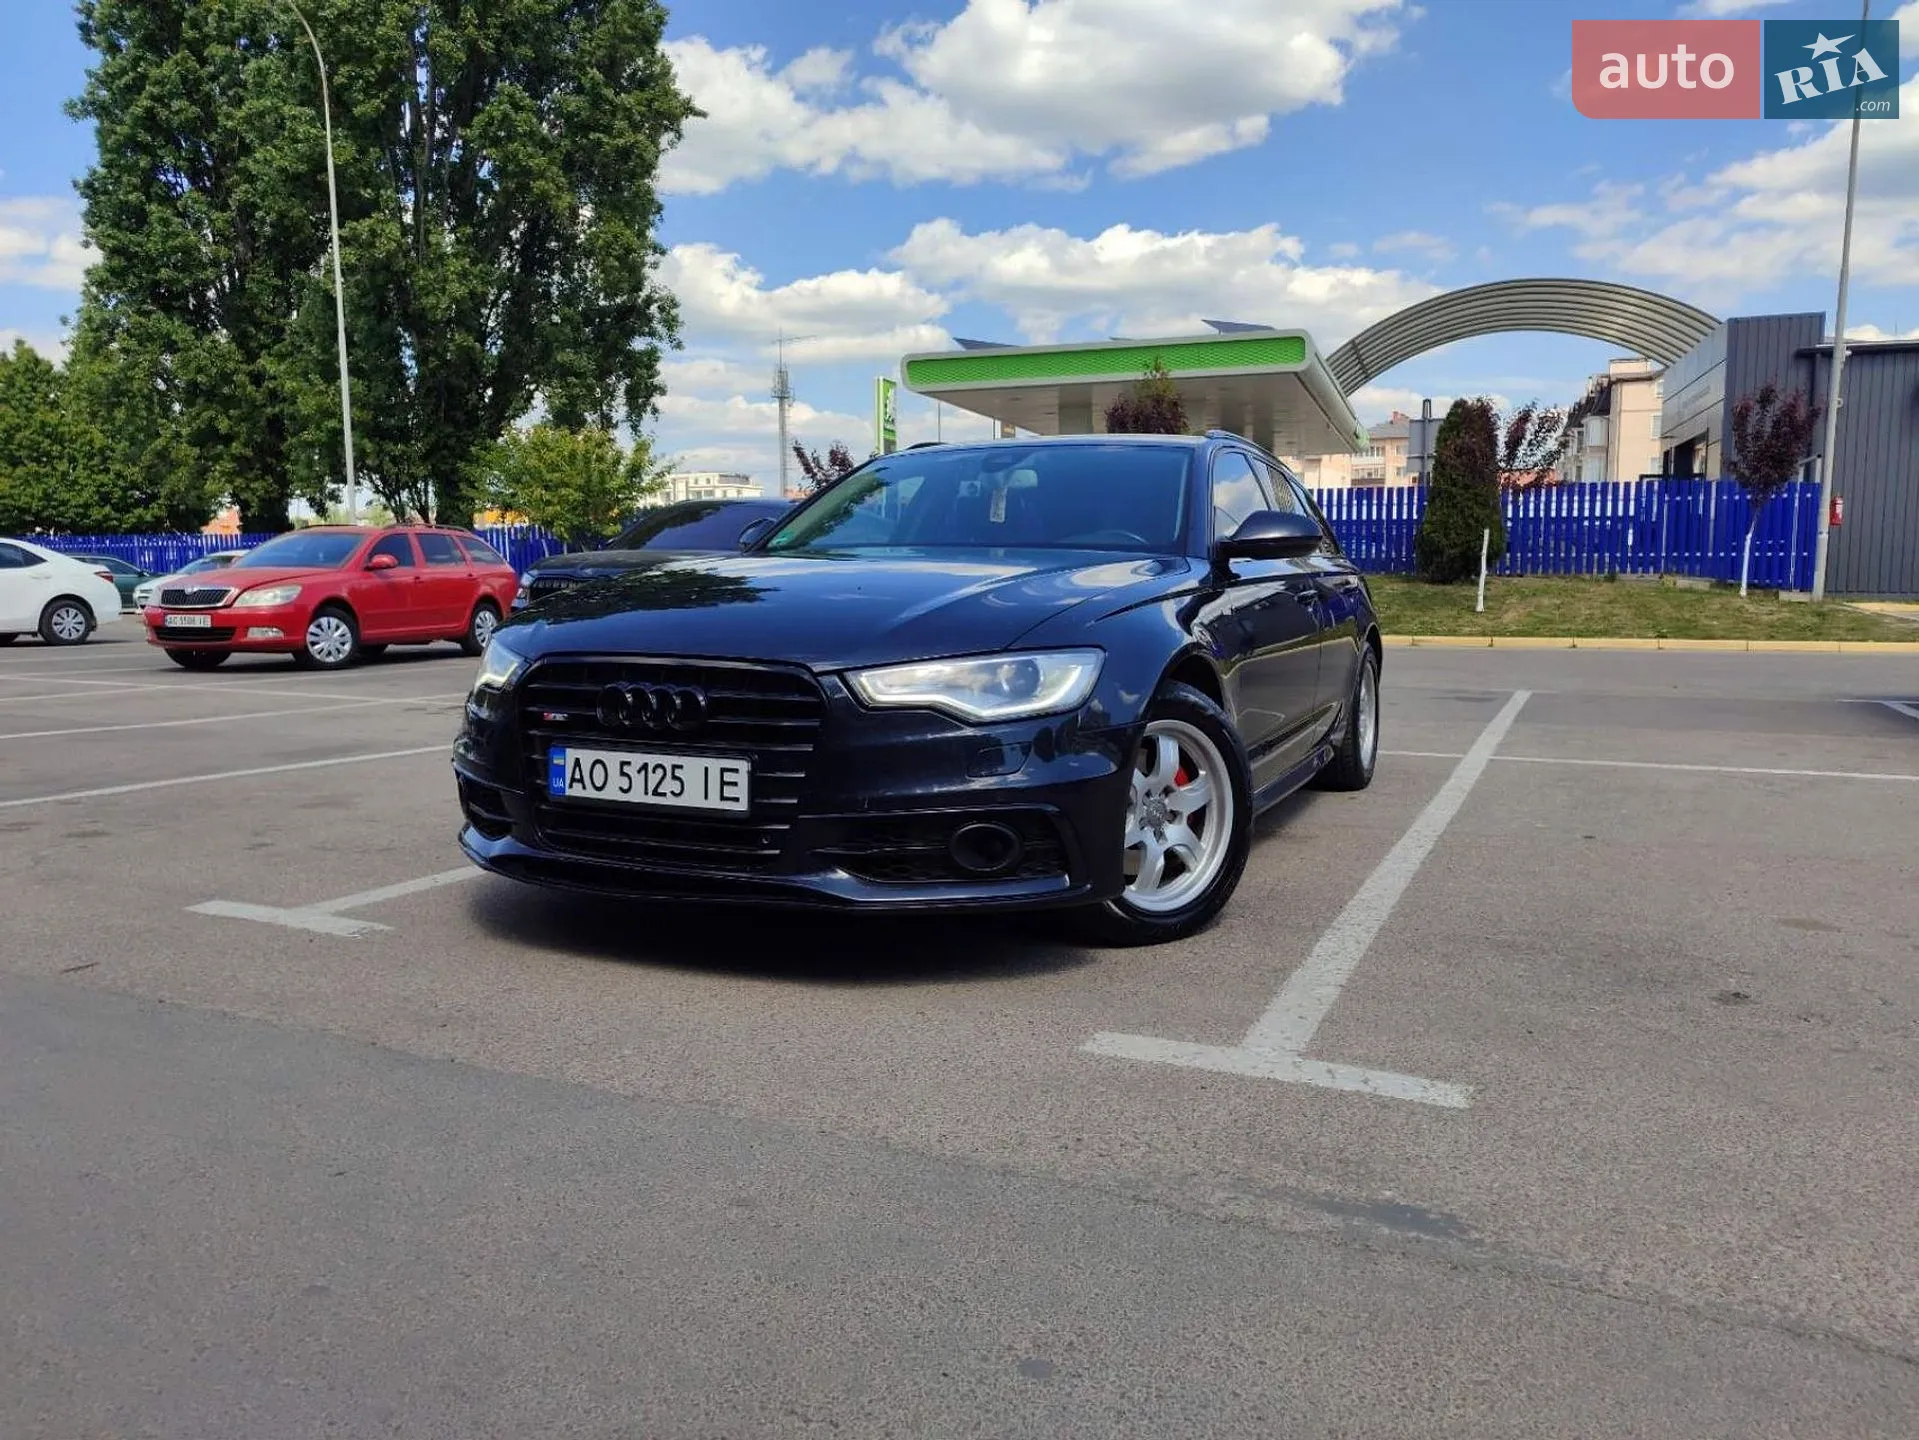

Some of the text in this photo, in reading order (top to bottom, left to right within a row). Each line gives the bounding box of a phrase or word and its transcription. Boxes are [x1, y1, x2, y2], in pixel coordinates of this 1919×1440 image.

[552, 777, 564, 788] UA
[568, 757, 740, 803] AO 5125 IE
